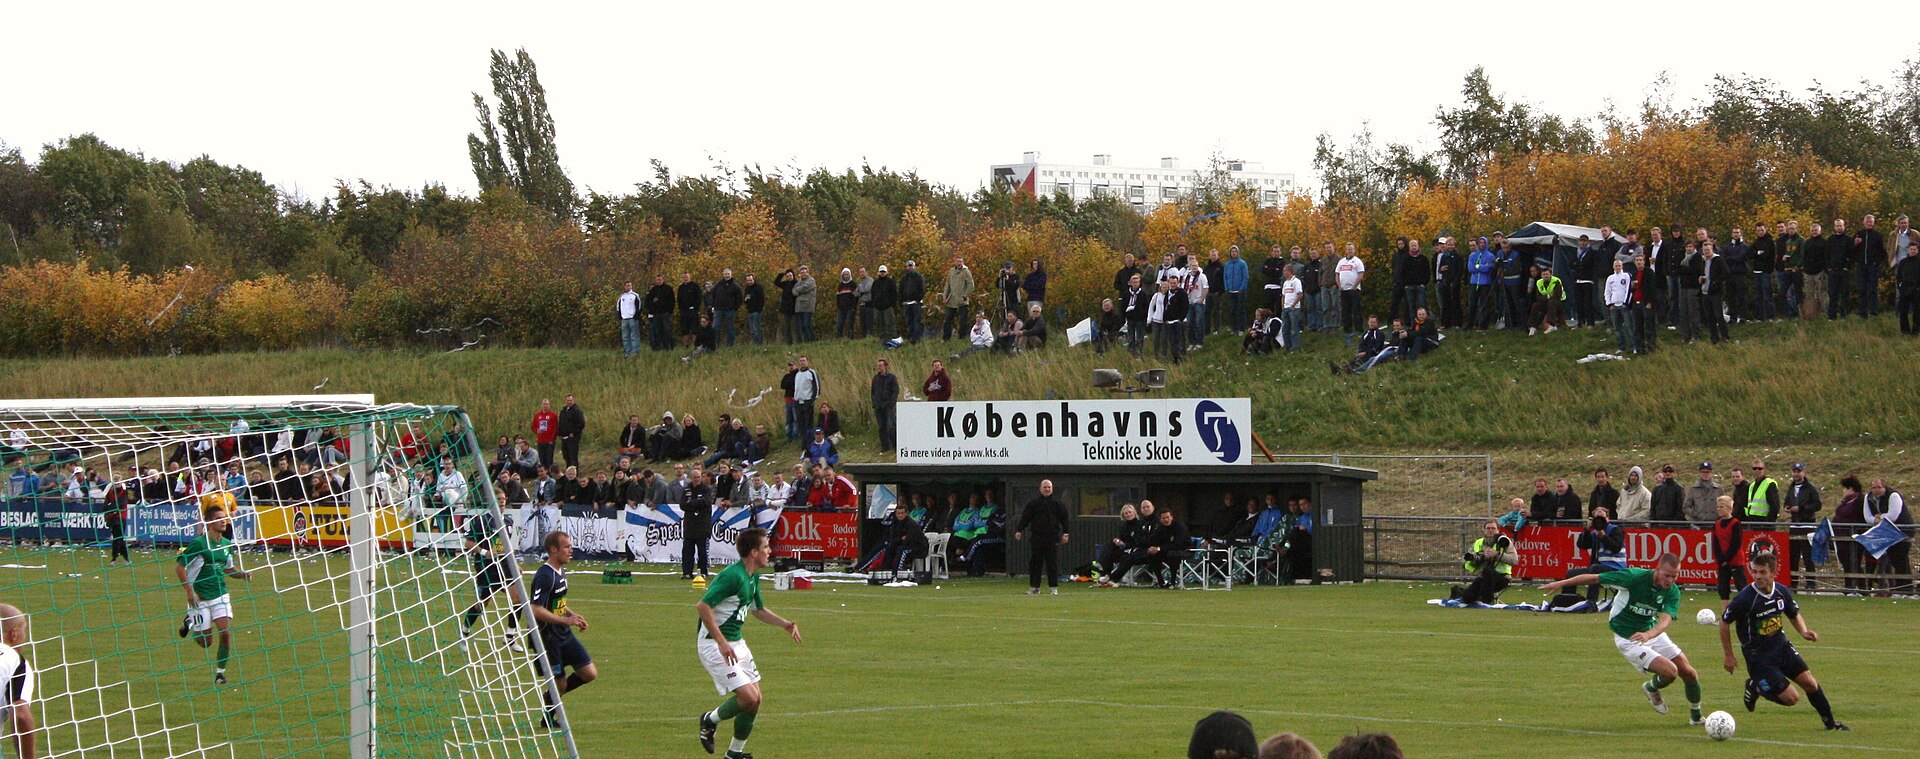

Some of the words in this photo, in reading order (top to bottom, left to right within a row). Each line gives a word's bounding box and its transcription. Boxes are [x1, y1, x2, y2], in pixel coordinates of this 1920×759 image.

[937, 402, 1182, 440] Københavns
[900, 447, 909, 458] Få
[911, 449, 929, 458] mere
[931, 447, 951, 458] viden
[952, 447, 962, 460] på
[964, 448, 1009, 458] www.kts.dk
[1083, 440, 1141, 460] Tekniske
[1146, 440, 1182, 460] Skole
[0, 511, 38, 528] BESLAG
[61, 512, 109, 529] VÆRKTØ
[646, 521, 684, 547] Spea
[711, 519, 741, 546] Cor
[833, 523, 858, 534] Rødov
[1511, 538, 1551, 551] ødovre
[1531, 554, 1543, 567] 11
[1546, 553, 1559, 567] 64
[194, 614, 204, 625] 10
